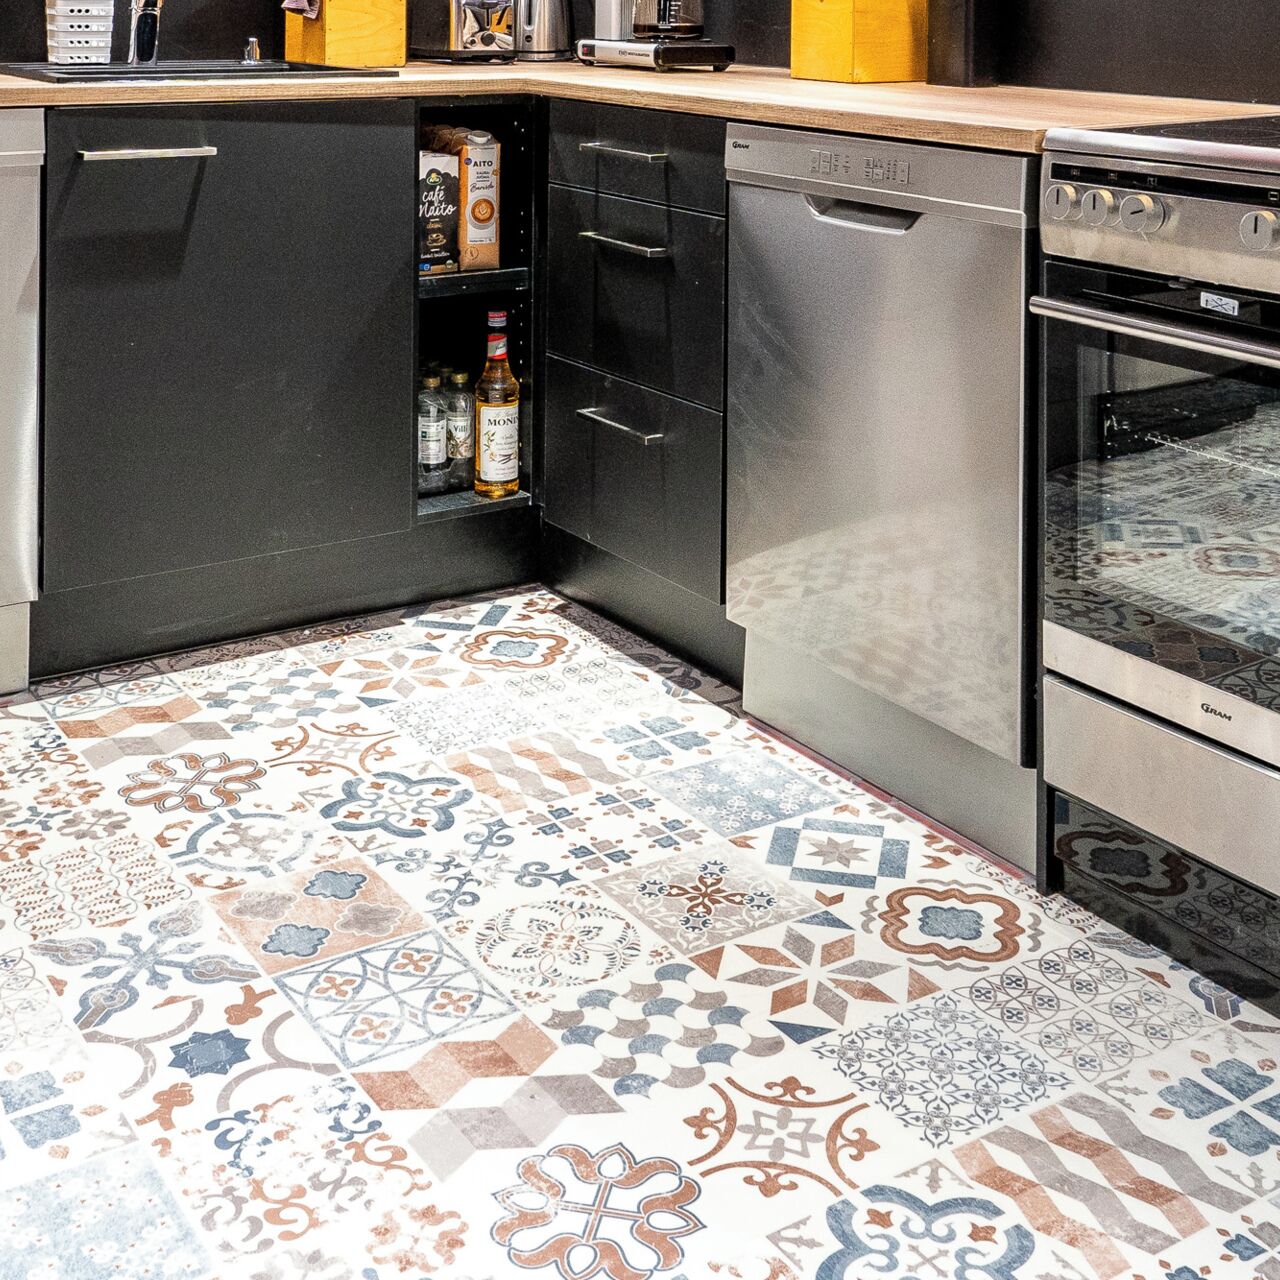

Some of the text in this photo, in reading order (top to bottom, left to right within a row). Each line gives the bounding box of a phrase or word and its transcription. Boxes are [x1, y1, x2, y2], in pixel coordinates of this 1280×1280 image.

[473, 160, 493, 168] AITO
[422, 186, 445, 206] café
[1200, 702, 1232, 722] GRAM
